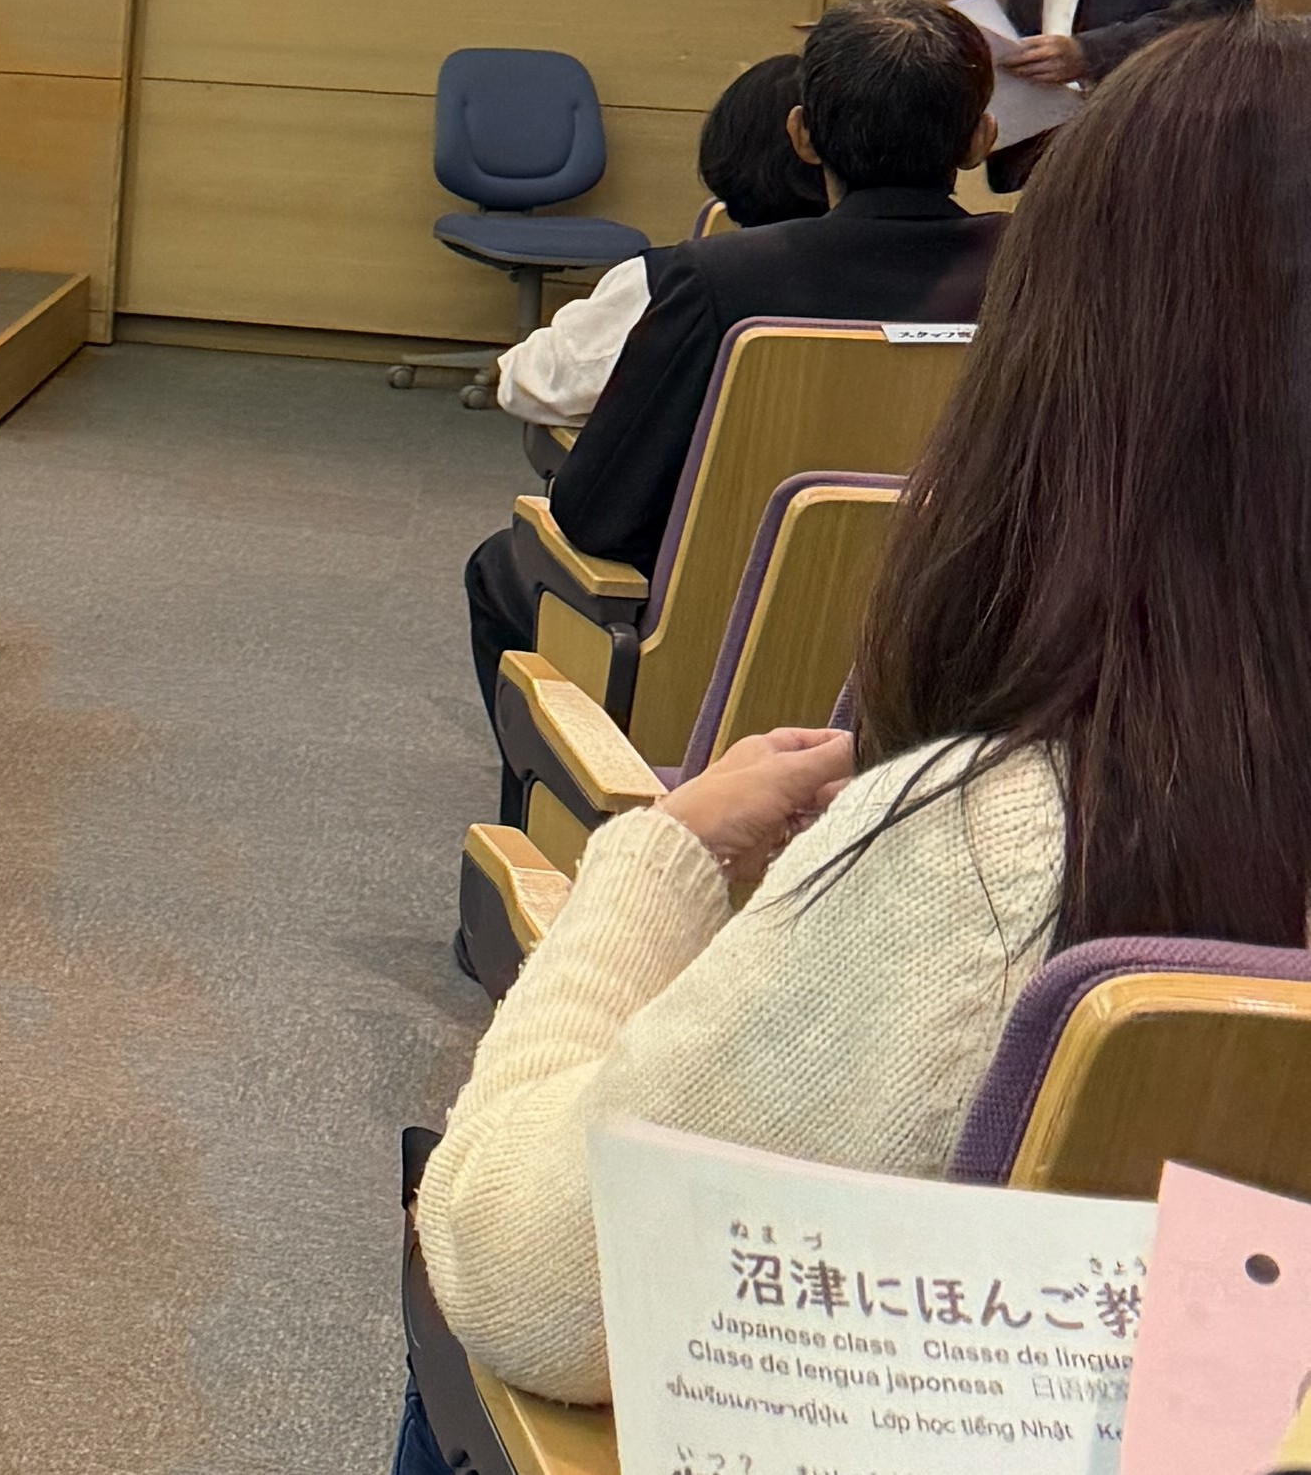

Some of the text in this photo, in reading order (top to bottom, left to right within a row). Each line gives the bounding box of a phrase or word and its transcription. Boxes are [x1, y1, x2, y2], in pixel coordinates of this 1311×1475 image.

[730, 1247, 1143, 1339] 沼津にほんご教
[711, 1311, 826, 1349] Japanese
[833, 1332, 897, 1357] class
[923, 1339, 1009, 1365] Classe
[1017, 1345, 1048, 1366] de
[688, 1339, 1004, 1396] Clase de lengua japonesa
